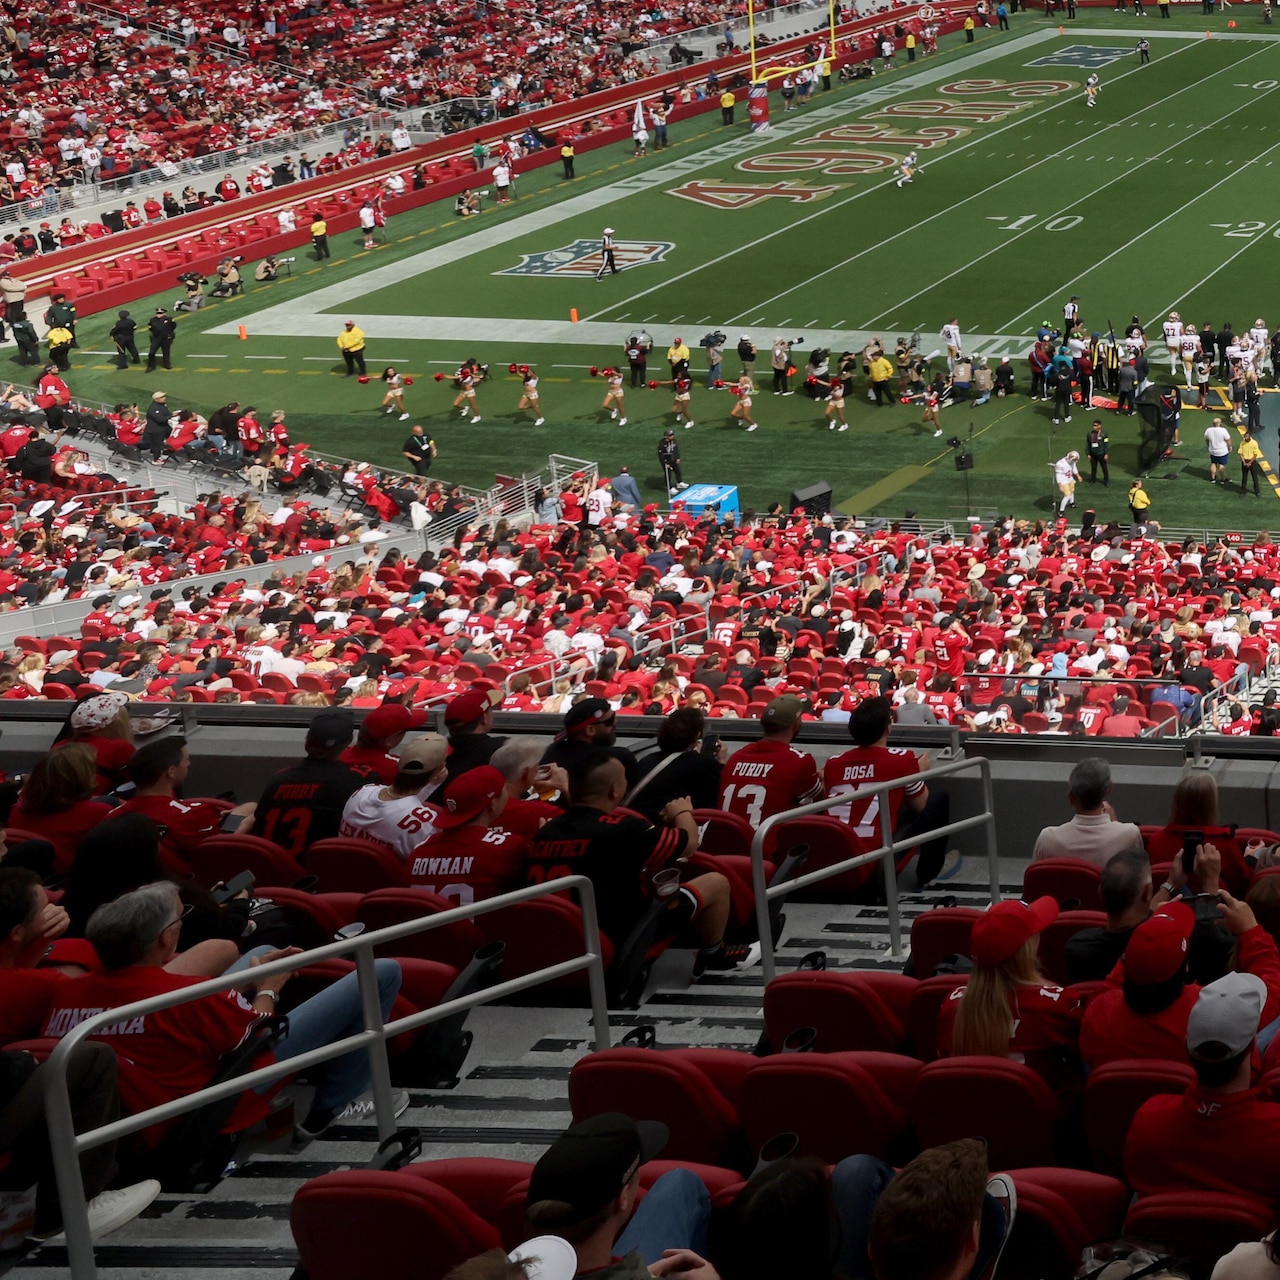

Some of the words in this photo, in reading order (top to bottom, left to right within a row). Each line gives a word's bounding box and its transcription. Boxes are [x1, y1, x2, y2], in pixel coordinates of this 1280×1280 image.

[664, 77, 1082, 210] 49ERS
[1000, 214, 1085, 232] 10
[714, 629, 733, 648] 16
[935, 647, 949, 661] 21
[1079, 712, 1094, 729] 10
[731, 762, 773, 778] PURDY
[843, 765, 875, 780] BOSA
[275, 783, 321, 801] PURDY
[722, 783, 767, 830] 13
[827, 782, 880, 837] 97
[397, 806, 434, 834] 56
[263, 806, 313, 855] 13
[411, 856, 474, 876] BOWMAN
[1197, 1100, 1221, 1117] SF
